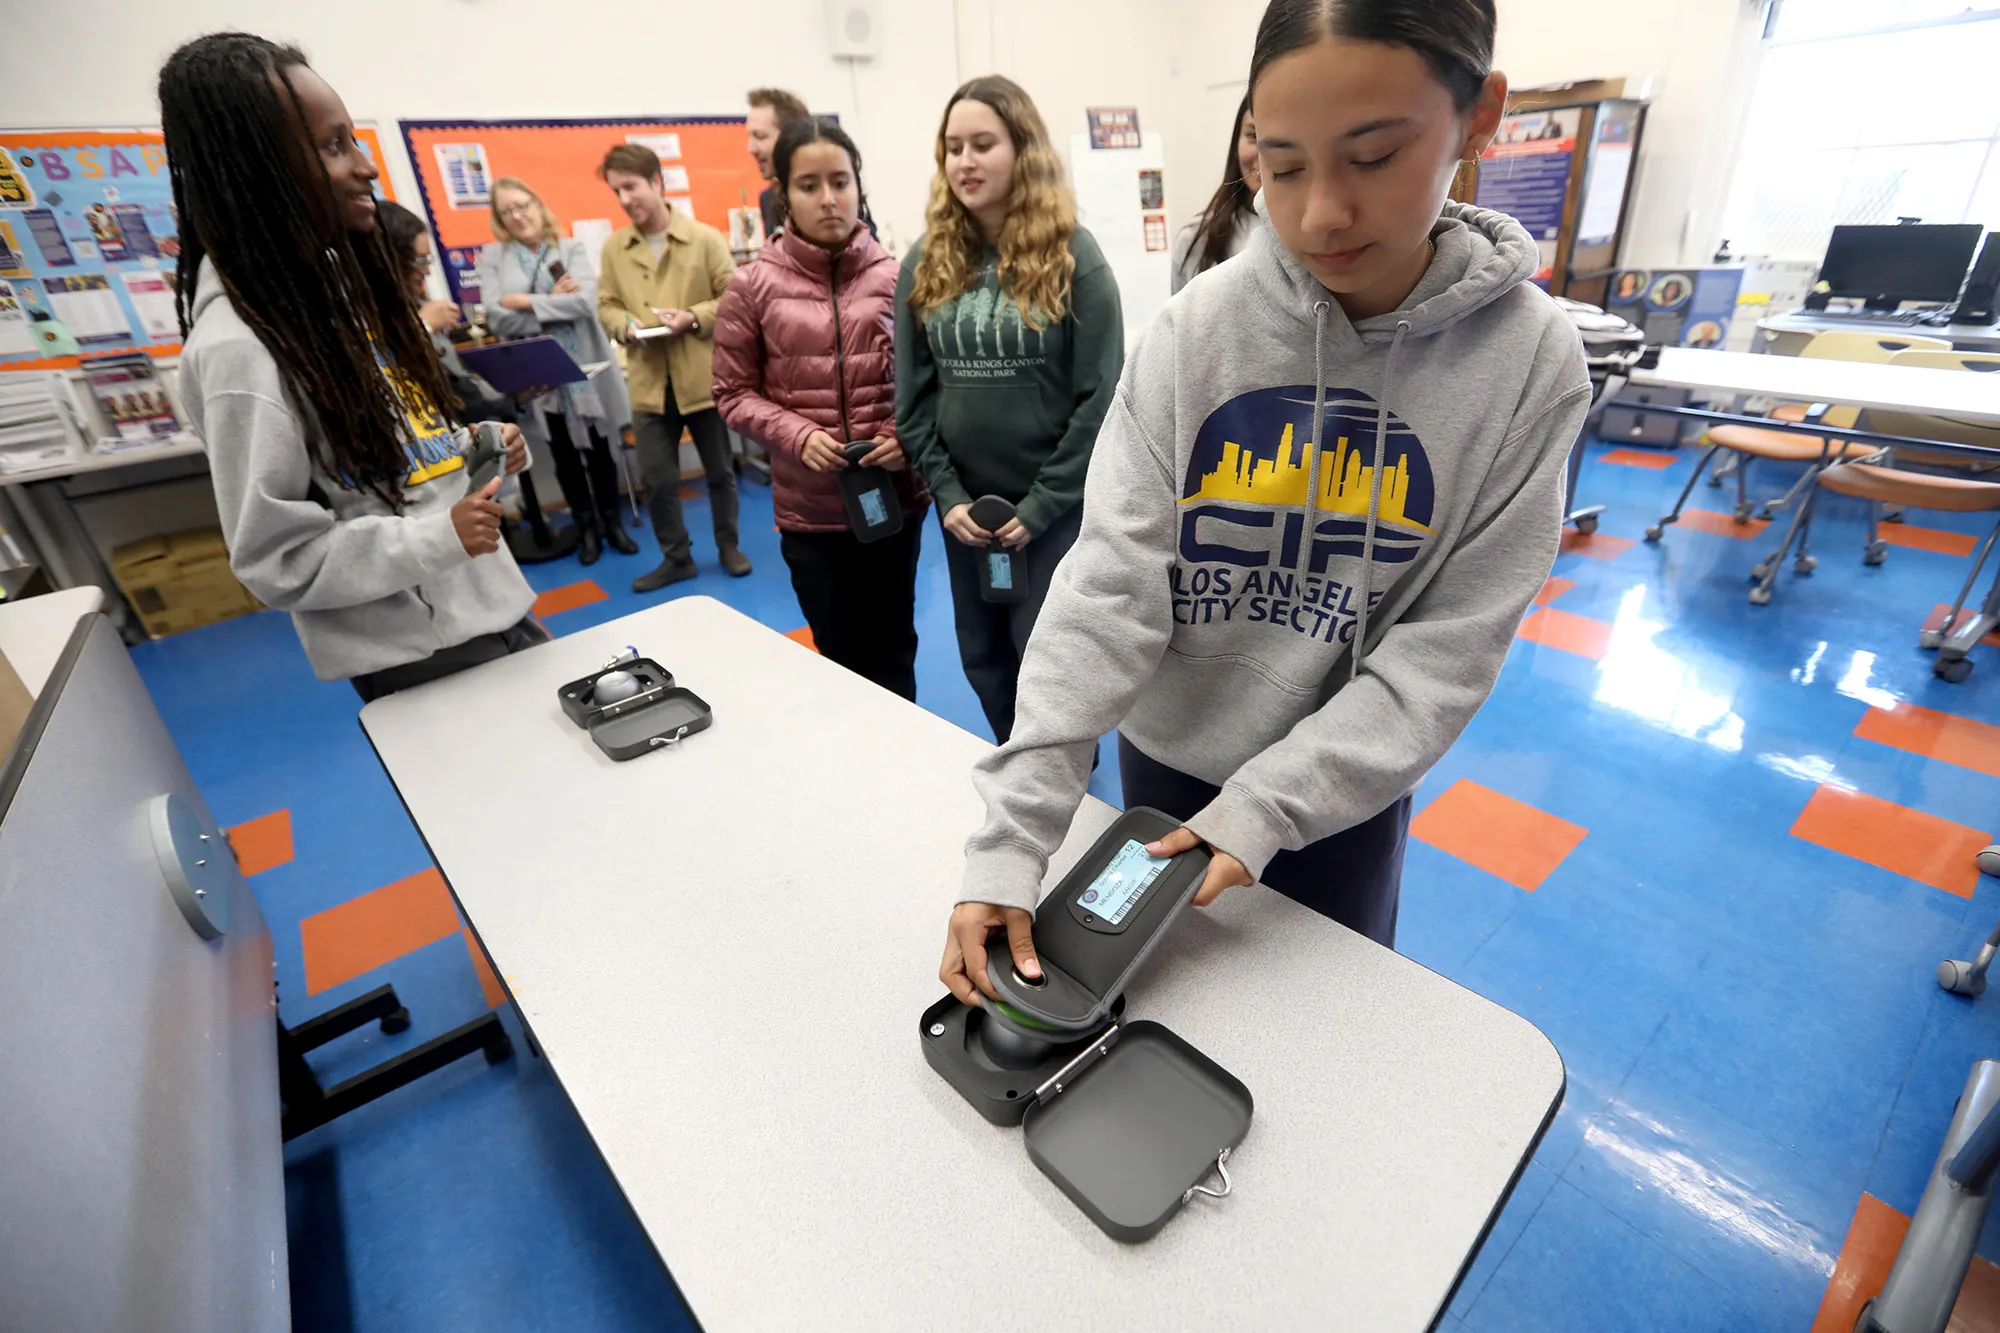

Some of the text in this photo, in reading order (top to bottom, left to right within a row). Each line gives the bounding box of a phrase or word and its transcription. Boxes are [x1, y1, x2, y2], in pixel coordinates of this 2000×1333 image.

[38, 149, 167, 181] BSAP
[952, 368, 1017, 378] NATIONAL PARK
[973, 359, 1002, 368] KINGS
[1003, 357, 1046, 367] CANYON
[1173, 567, 1385, 616] LOS ANGELE
[1172, 597, 1358, 644] CITY SECTIO
[1124, 842, 1136, 854] 12
[1098, 877, 1125, 907] MENDOZA
[1121, 877, 1139, 897] ANGIE
